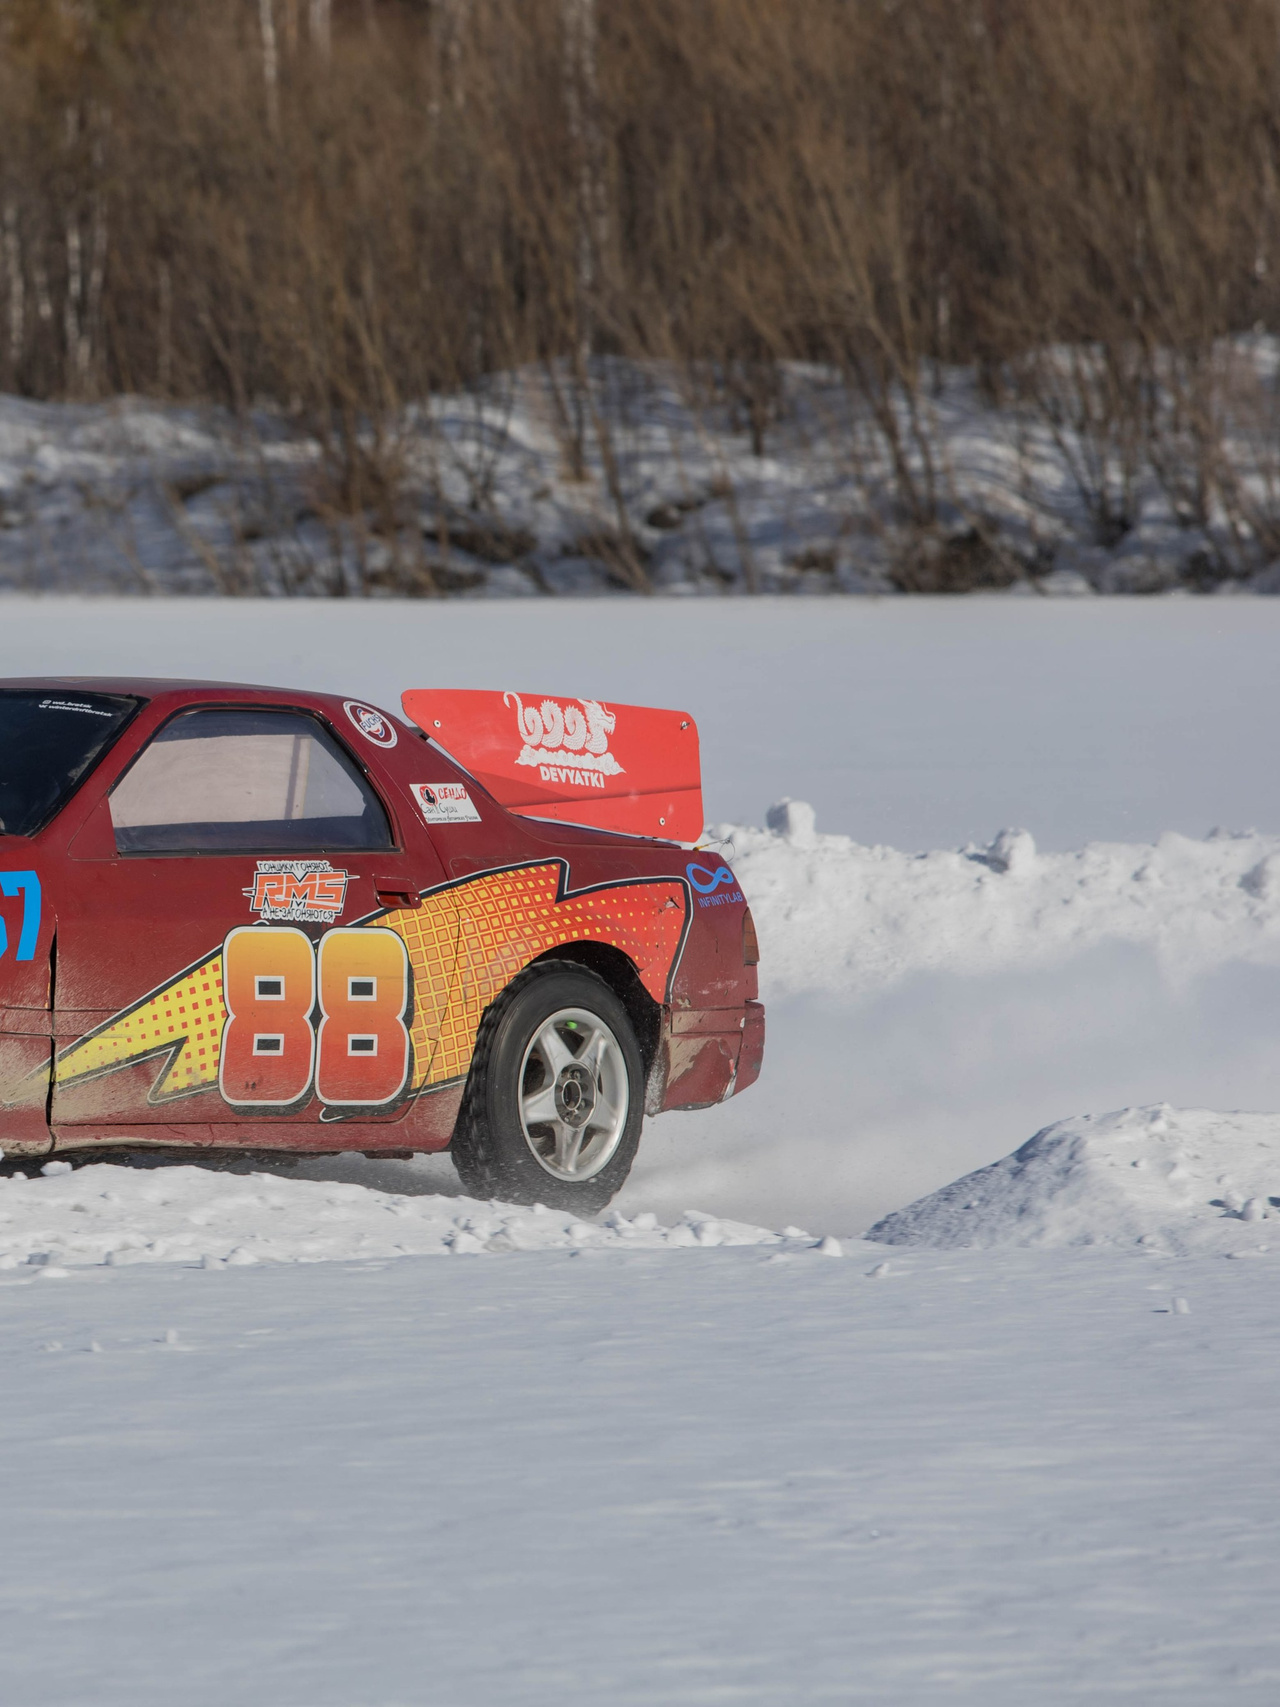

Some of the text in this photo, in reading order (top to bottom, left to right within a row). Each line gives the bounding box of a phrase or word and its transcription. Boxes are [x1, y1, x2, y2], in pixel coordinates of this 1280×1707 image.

[360, 713, 382, 731] FUCHS
[539, 765, 605, 788] DEVYATKI
[254, 872, 345, 911] RMS
[698, 891, 743, 908] INFINITYLAB
[281, 907, 334, 920] ЗАГОНЯЮТСЯ
[219, 926, 410, 1108] 88
